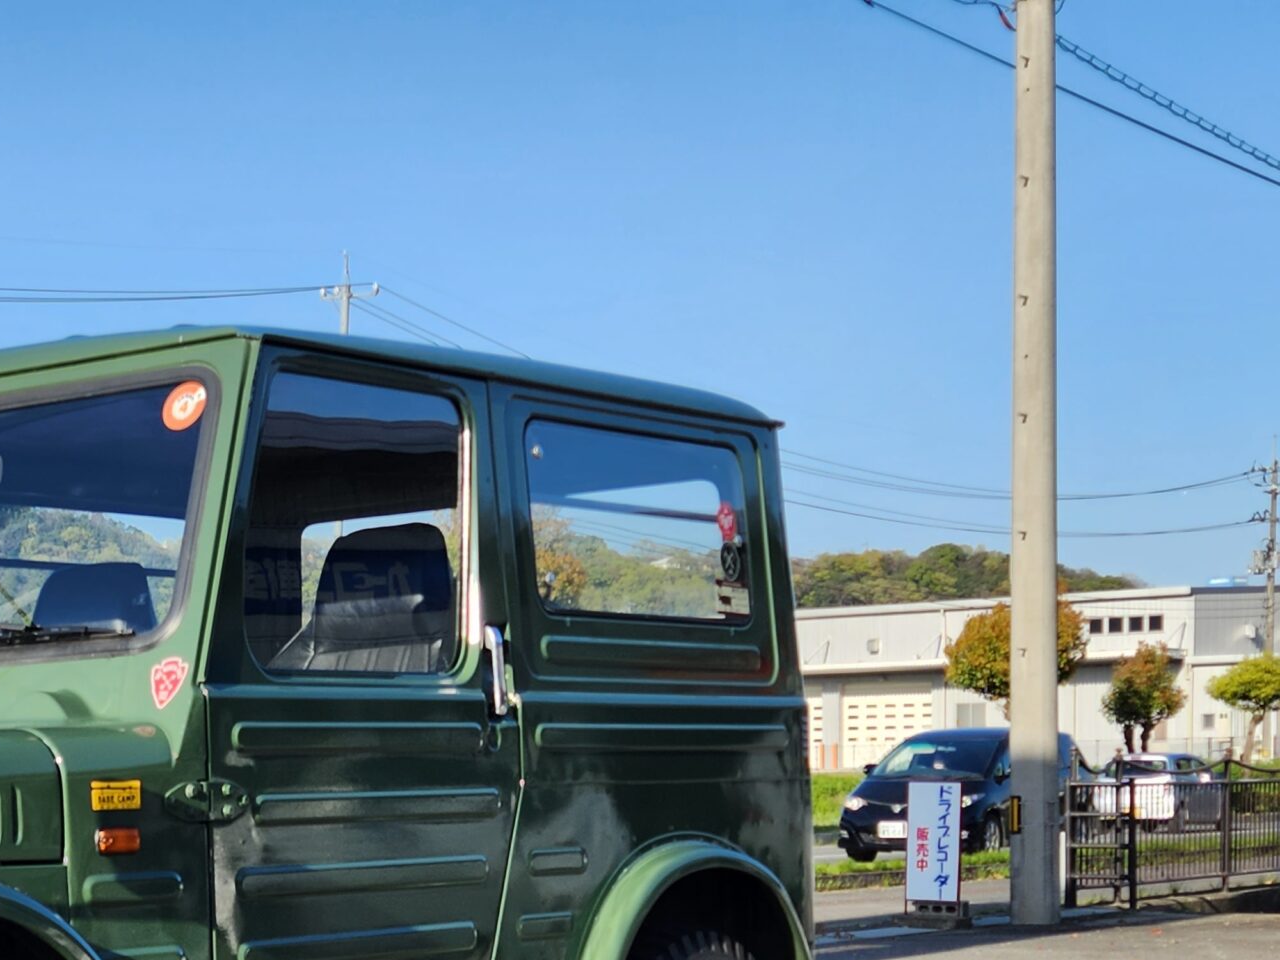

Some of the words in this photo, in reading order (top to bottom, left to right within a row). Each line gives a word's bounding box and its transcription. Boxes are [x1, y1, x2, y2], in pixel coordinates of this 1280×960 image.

[118, 794, 136, 803] CAMP
[916, 827, 929, 872] 販売中
[932, 785, 953, 900] ドライブレコーダー
